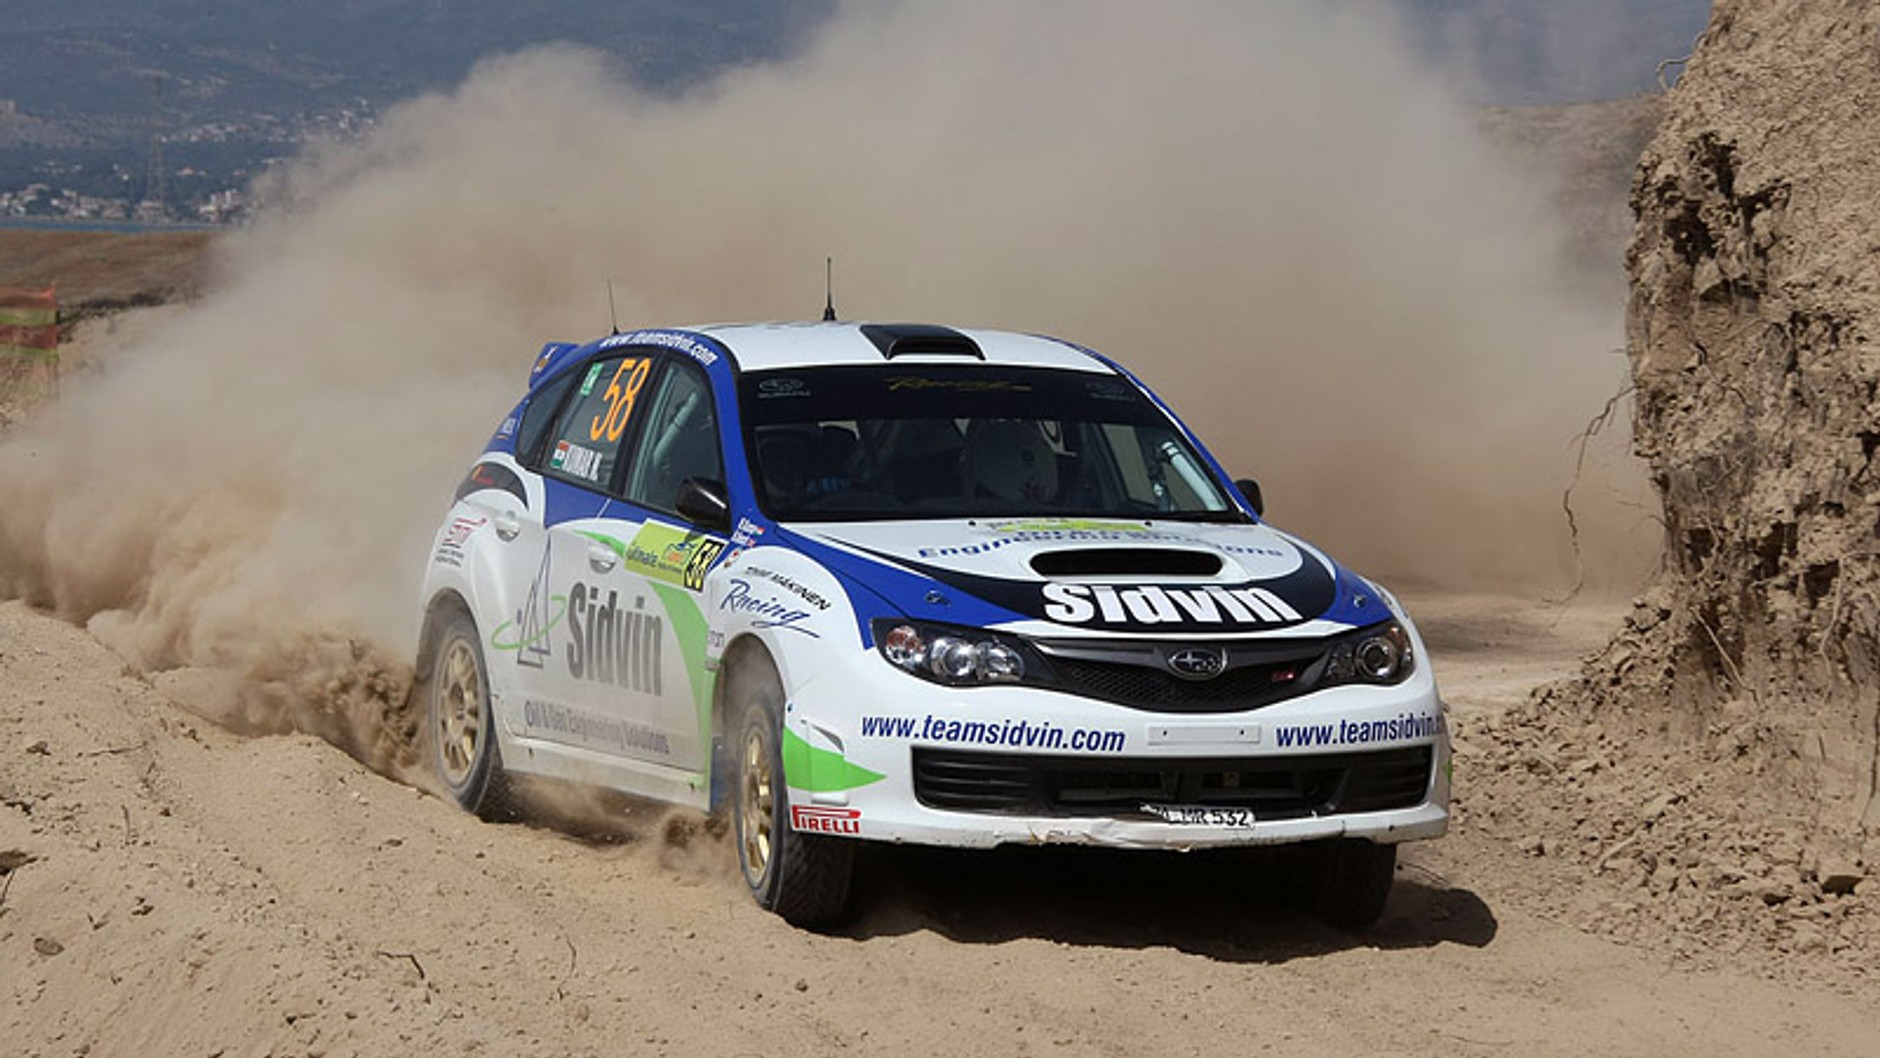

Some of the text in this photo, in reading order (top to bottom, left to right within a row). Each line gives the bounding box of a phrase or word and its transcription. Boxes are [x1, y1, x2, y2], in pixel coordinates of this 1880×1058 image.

[599, 331, 718, 366] www.teamsidvin.com
[590, 357, 651, 442] 58
[720, 578, 820, 638] Racing
[1041, 582, 1303, 625] Sidvin
[565, 581, 663, 697] Sidvin
[862, 714, 1126, 751] www.teamsidvin.com
[791, 804, 861, 834] PIRELLI
[1210, 808, 1249, 827] 532
